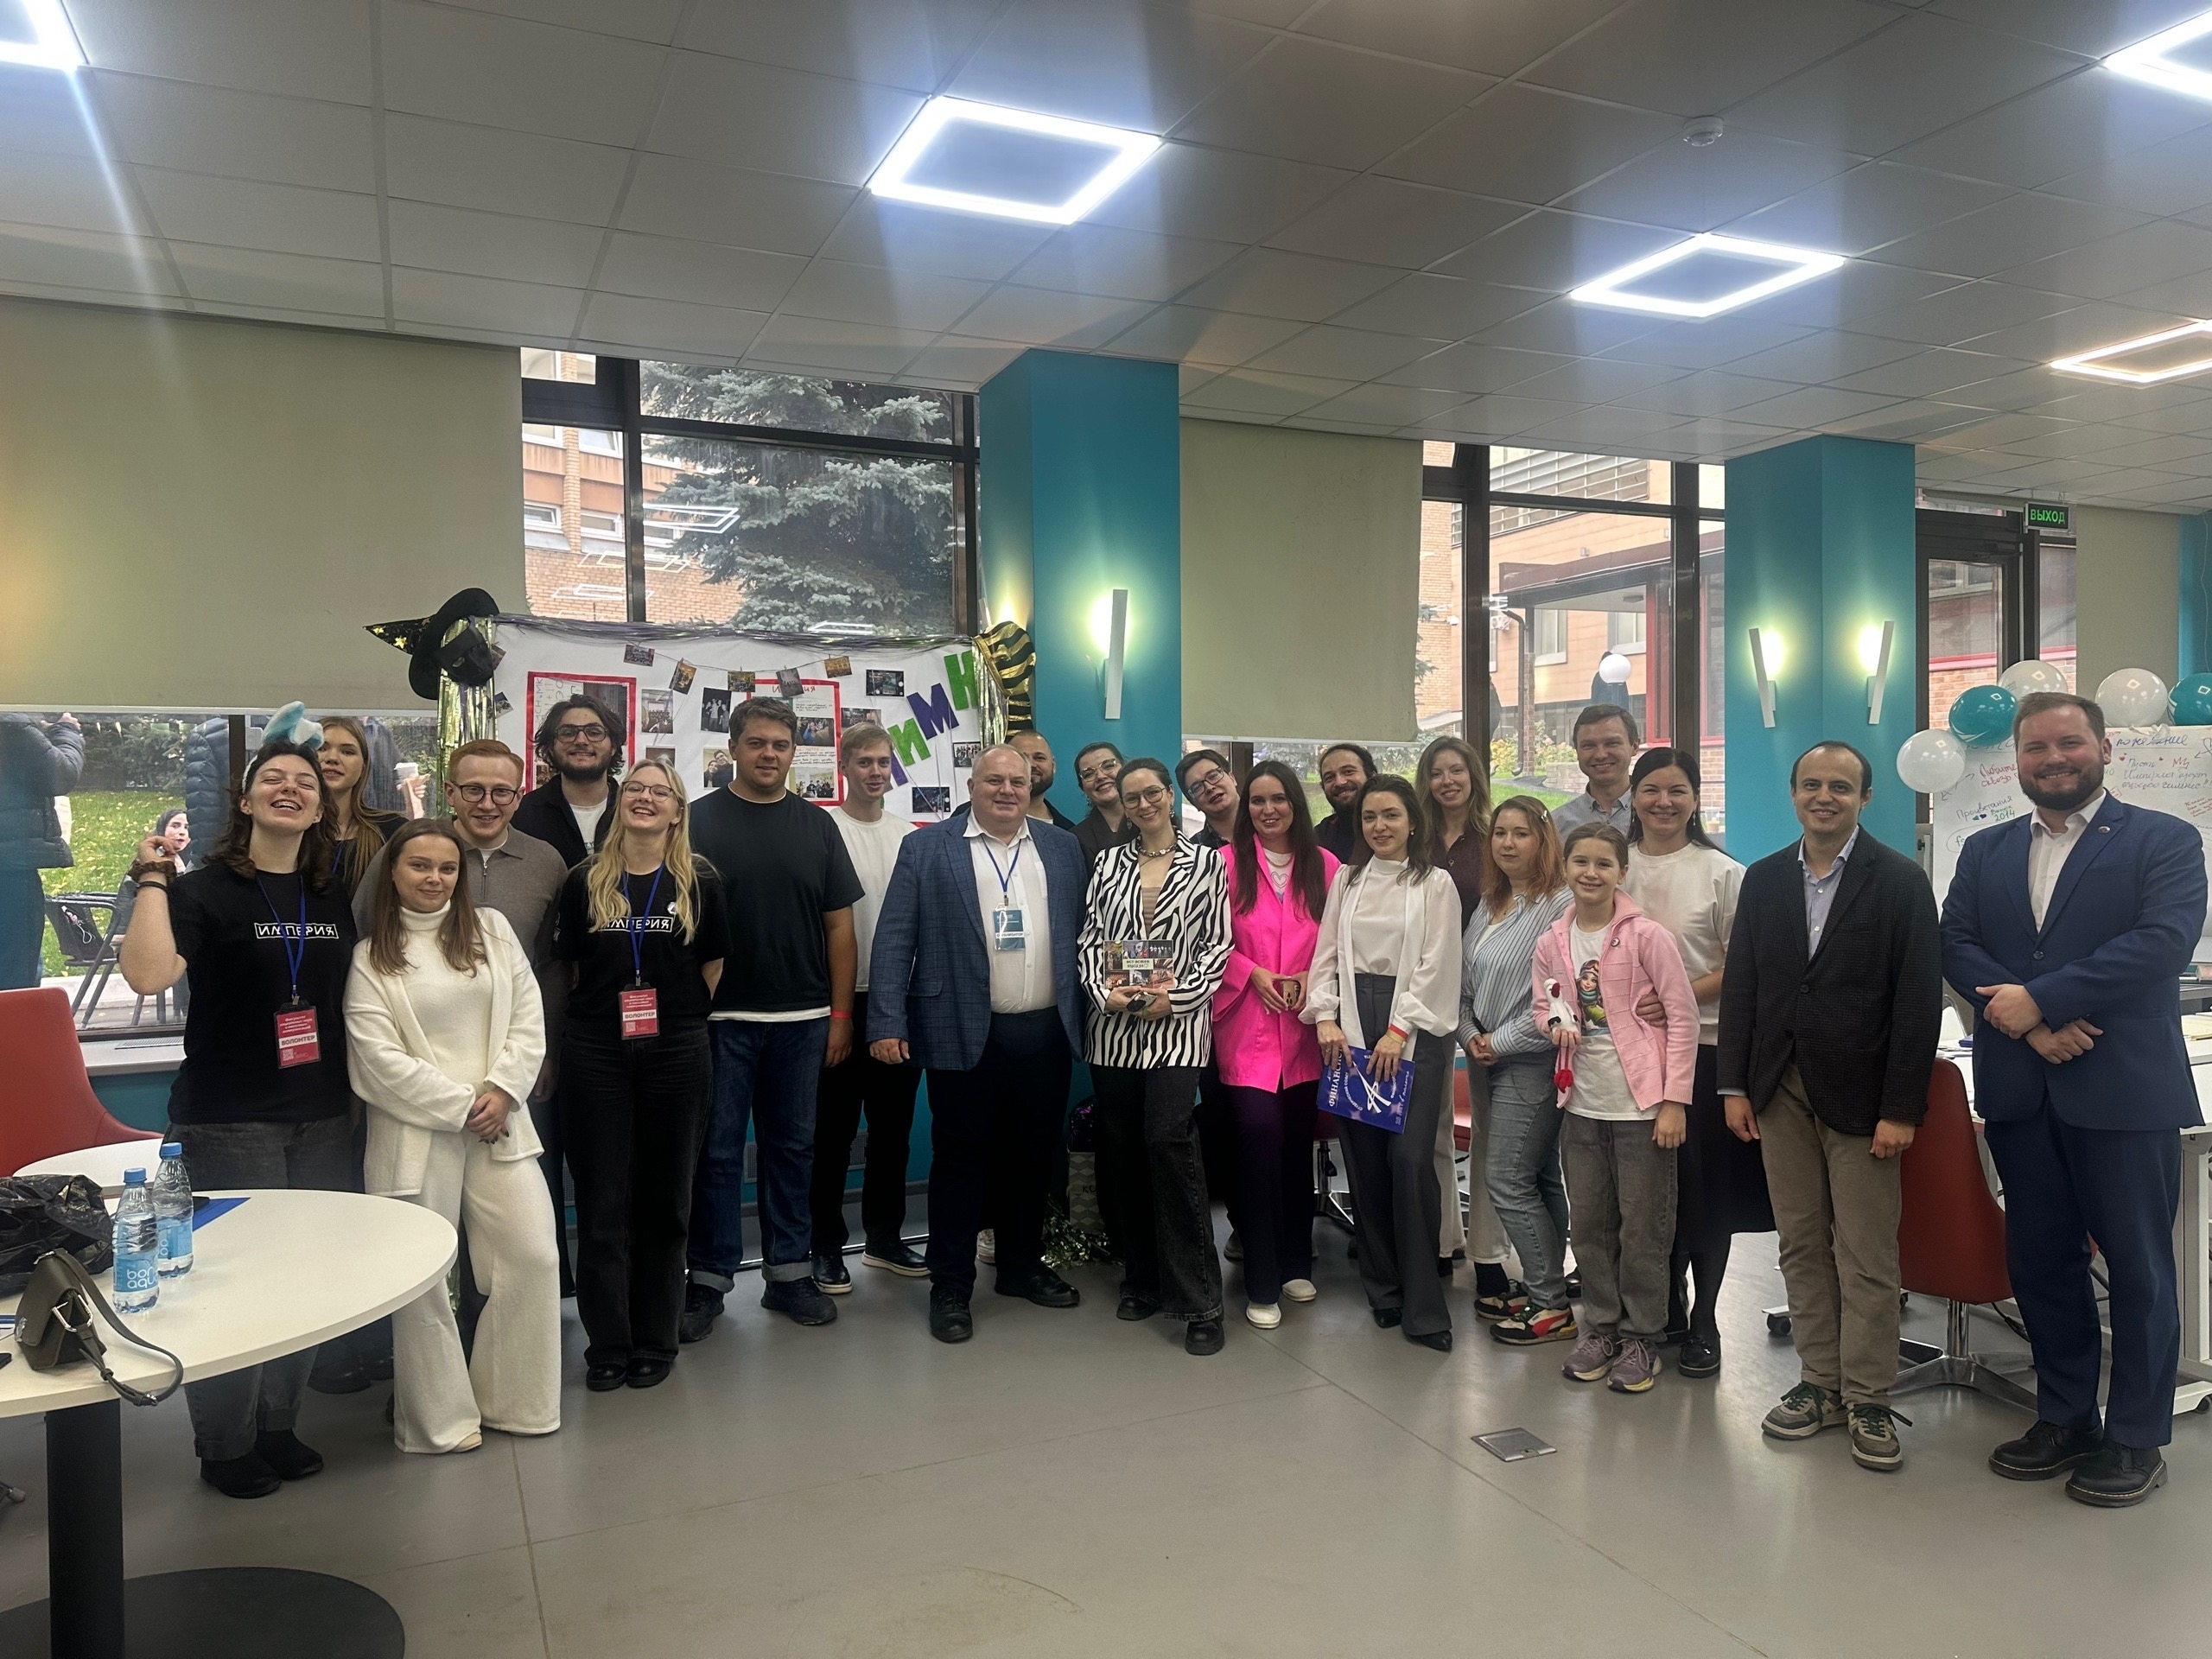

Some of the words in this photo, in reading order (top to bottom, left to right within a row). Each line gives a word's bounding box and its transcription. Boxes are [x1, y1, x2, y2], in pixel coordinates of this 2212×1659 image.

[2031, 509, 2066, 524] ВЫХОД
[1993, 809, 2016, 823] 2014
[605, 918, 670, 930] МПЕРИЯ
[281, 1035, 315, 1046] ВОЛОНТЕР
